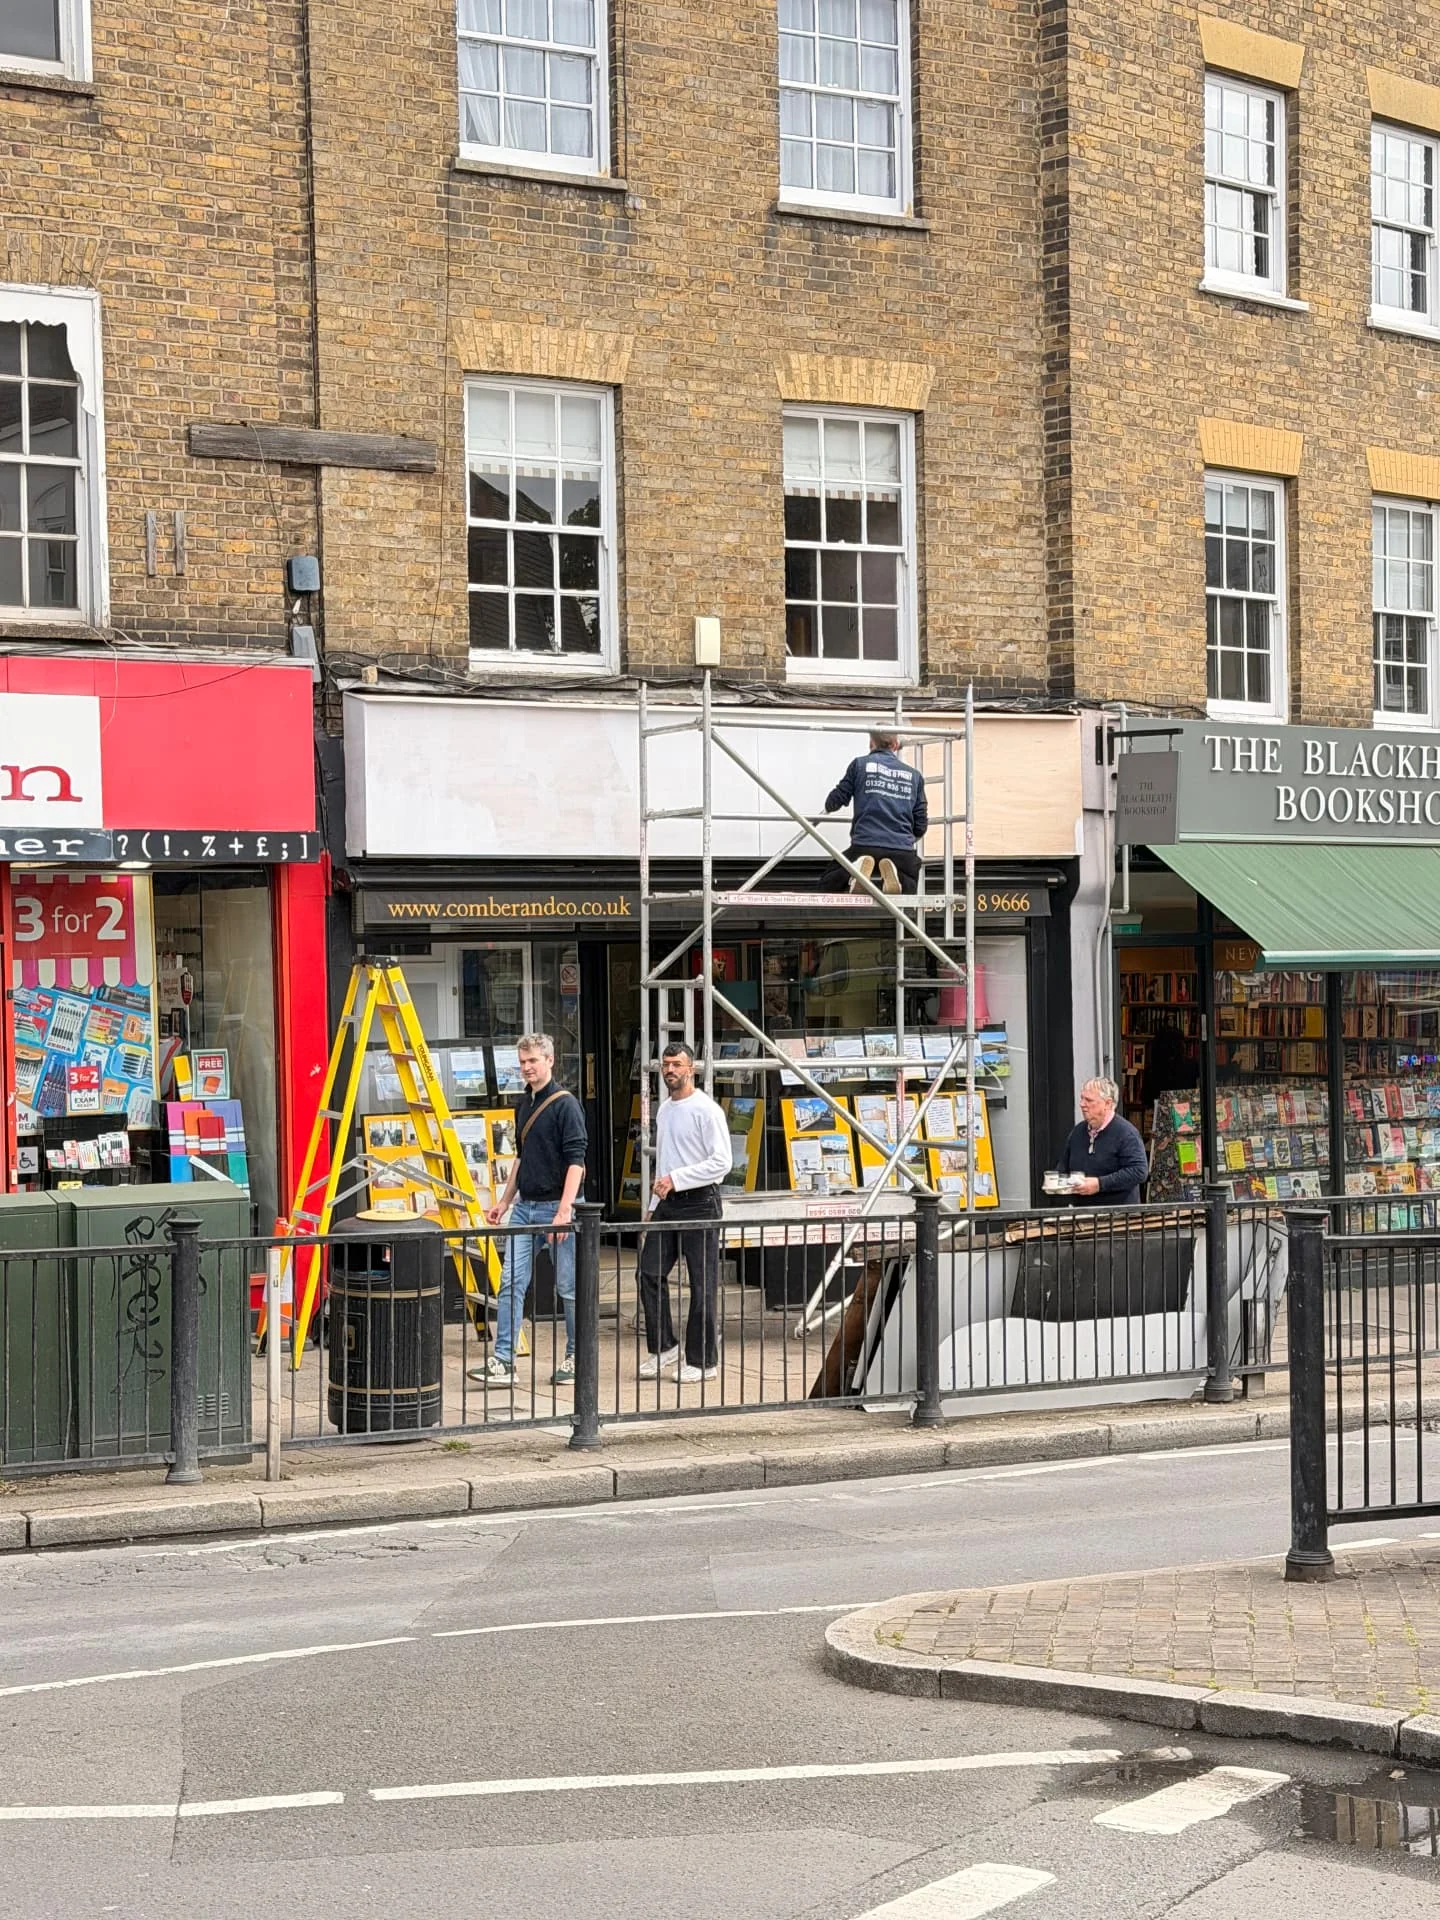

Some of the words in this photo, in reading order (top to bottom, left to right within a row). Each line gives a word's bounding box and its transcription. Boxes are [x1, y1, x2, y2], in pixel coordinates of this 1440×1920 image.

[1204, 735, 1283, 773] THE
[1303, 740, 1440, 779] BLACKH
[1276, 786, 1440, 825] BOOKSHO
[388, 896, 631, 917] www.comberandco.co.uk
[991, 892, 1031, 912] 9666
[15, 896, 45, 941] 3
[52, 905, 93, 933] for
[96, 896, 126, 940] 2
[199, 1060, 222, 1069] FREE
[70, 1072, 79, 1084] 3
[80, 1073, 90, 1082] for
[90, 1071, 99, 1083] 2
